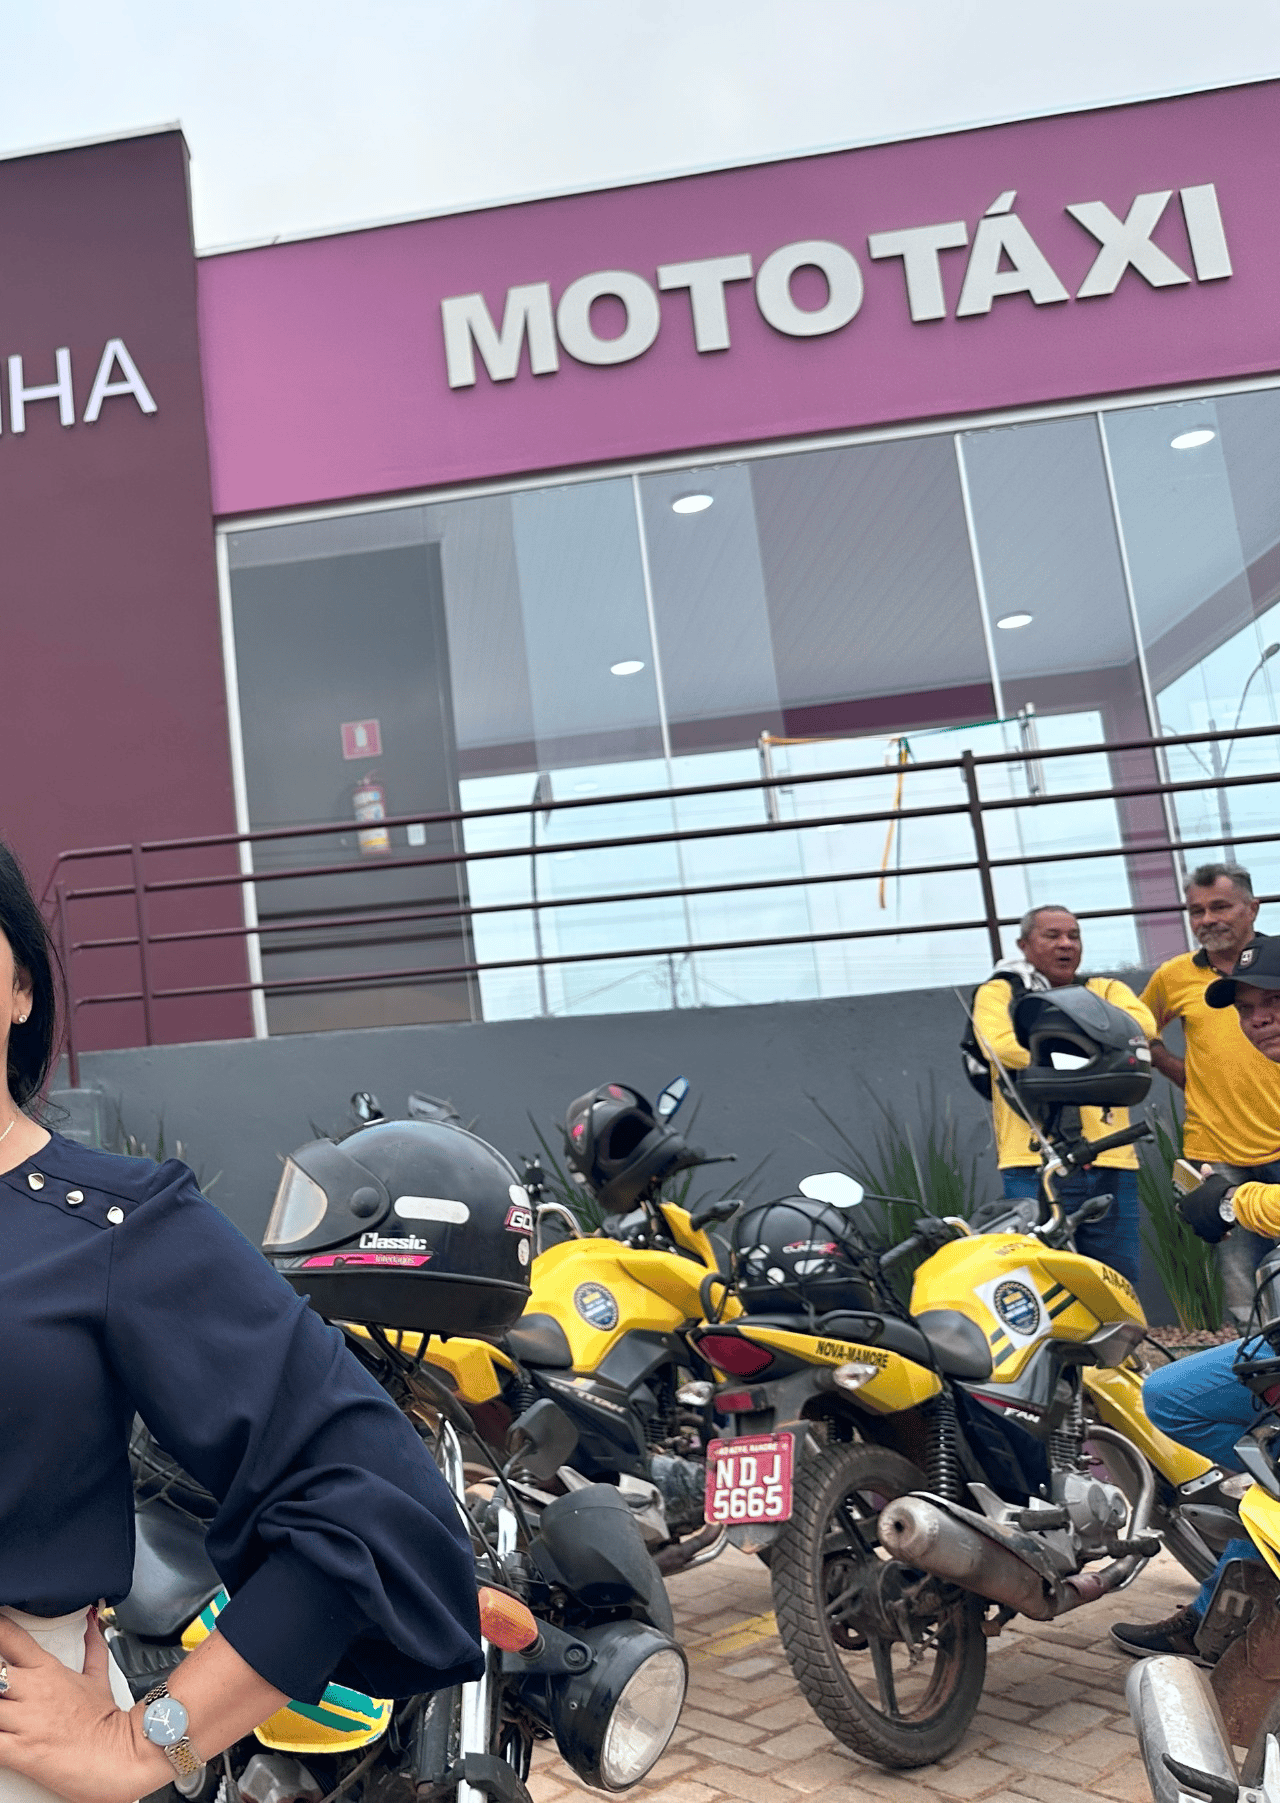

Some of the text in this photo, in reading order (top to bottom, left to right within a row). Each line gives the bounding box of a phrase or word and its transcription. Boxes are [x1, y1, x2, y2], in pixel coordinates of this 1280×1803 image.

[441, 183, 1234, 389] MOTOTÁXI
[359, 1232, 428, 1251] Classic
[1003, 1406, 1040, 1424] FAN
[713, 1484, 783, 1520] 5665
